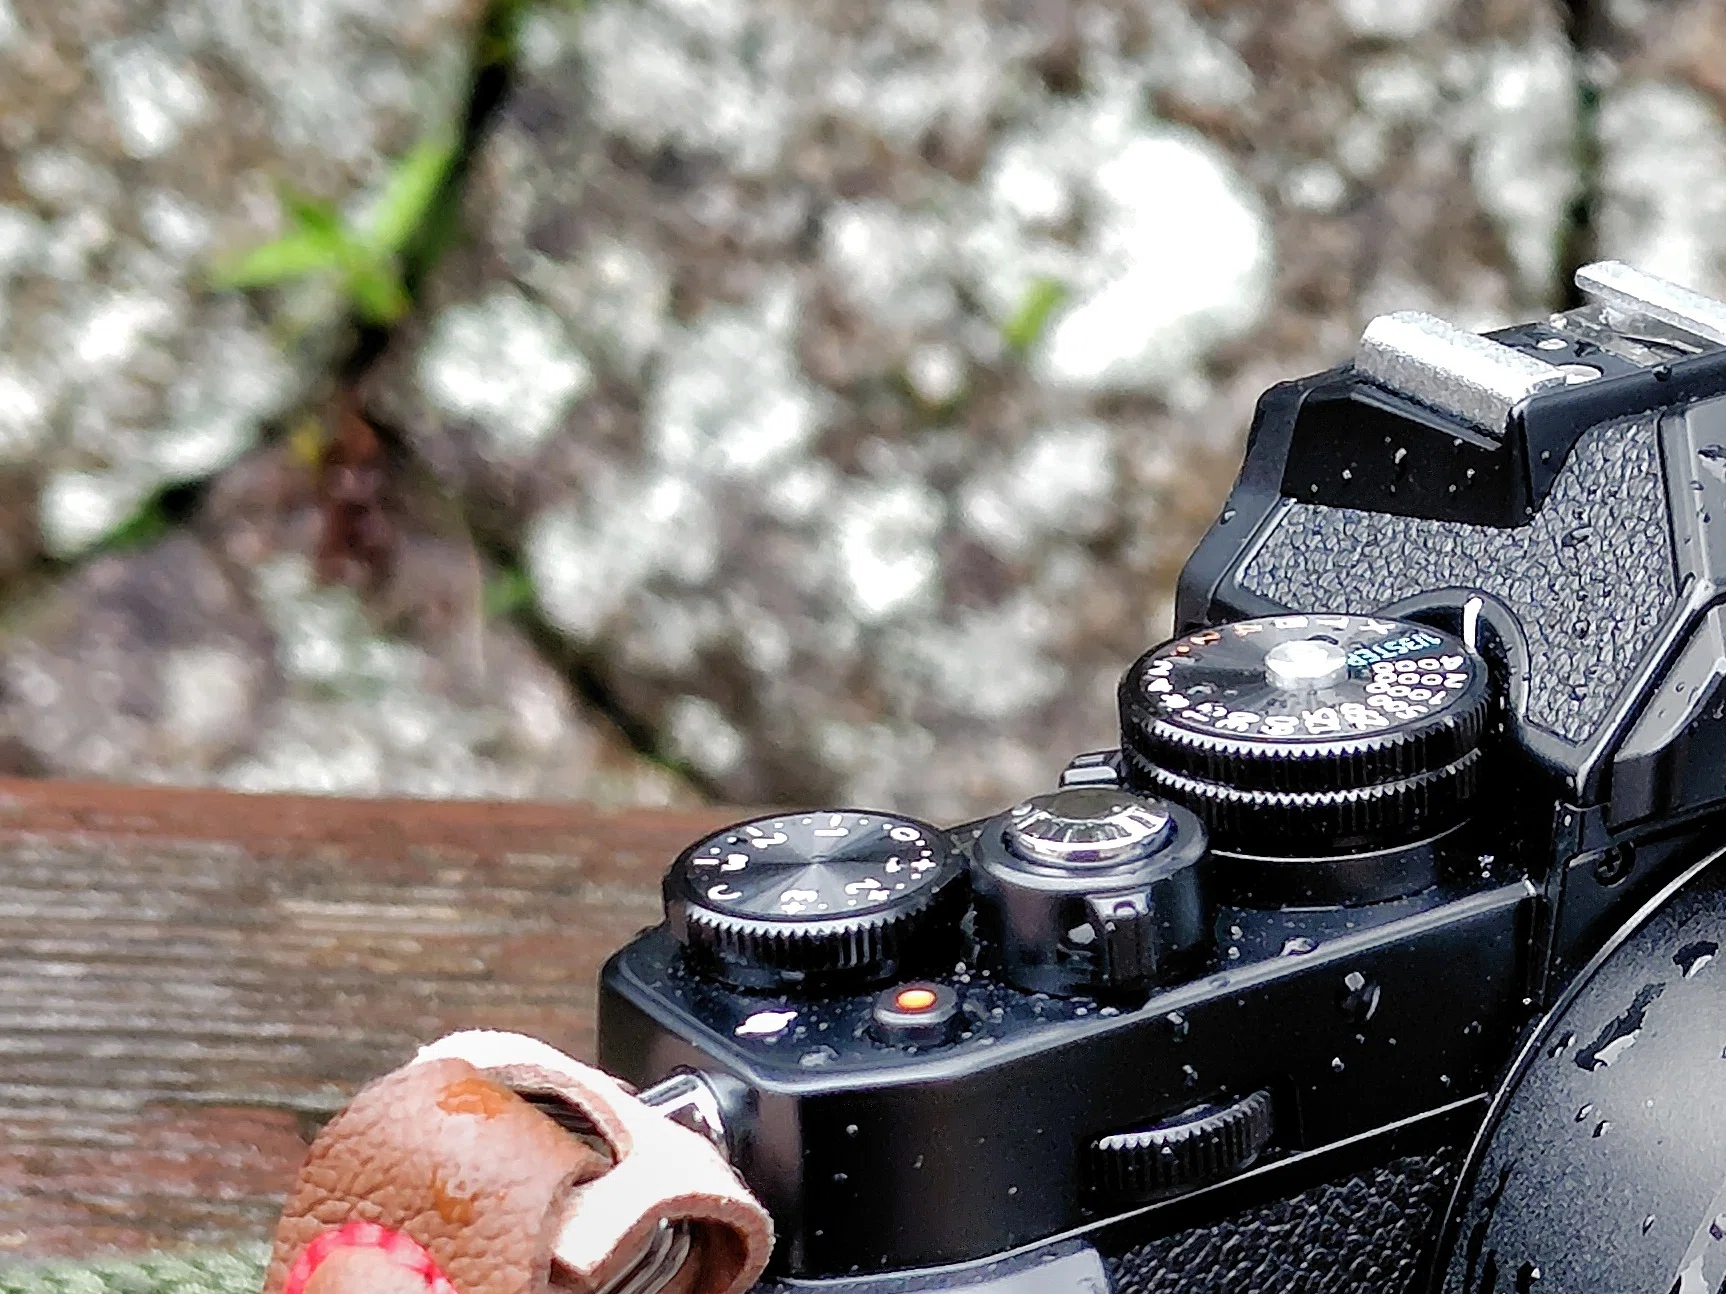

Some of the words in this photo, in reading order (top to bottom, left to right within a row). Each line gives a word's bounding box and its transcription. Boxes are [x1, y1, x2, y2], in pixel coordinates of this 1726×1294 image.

[1371, 656, 1464, 674] 4000
[1374, 673, 1468, 688] 2000
[1366, 682, 1447, 705] 1000
[1367, 695, 1428, 719] 500
